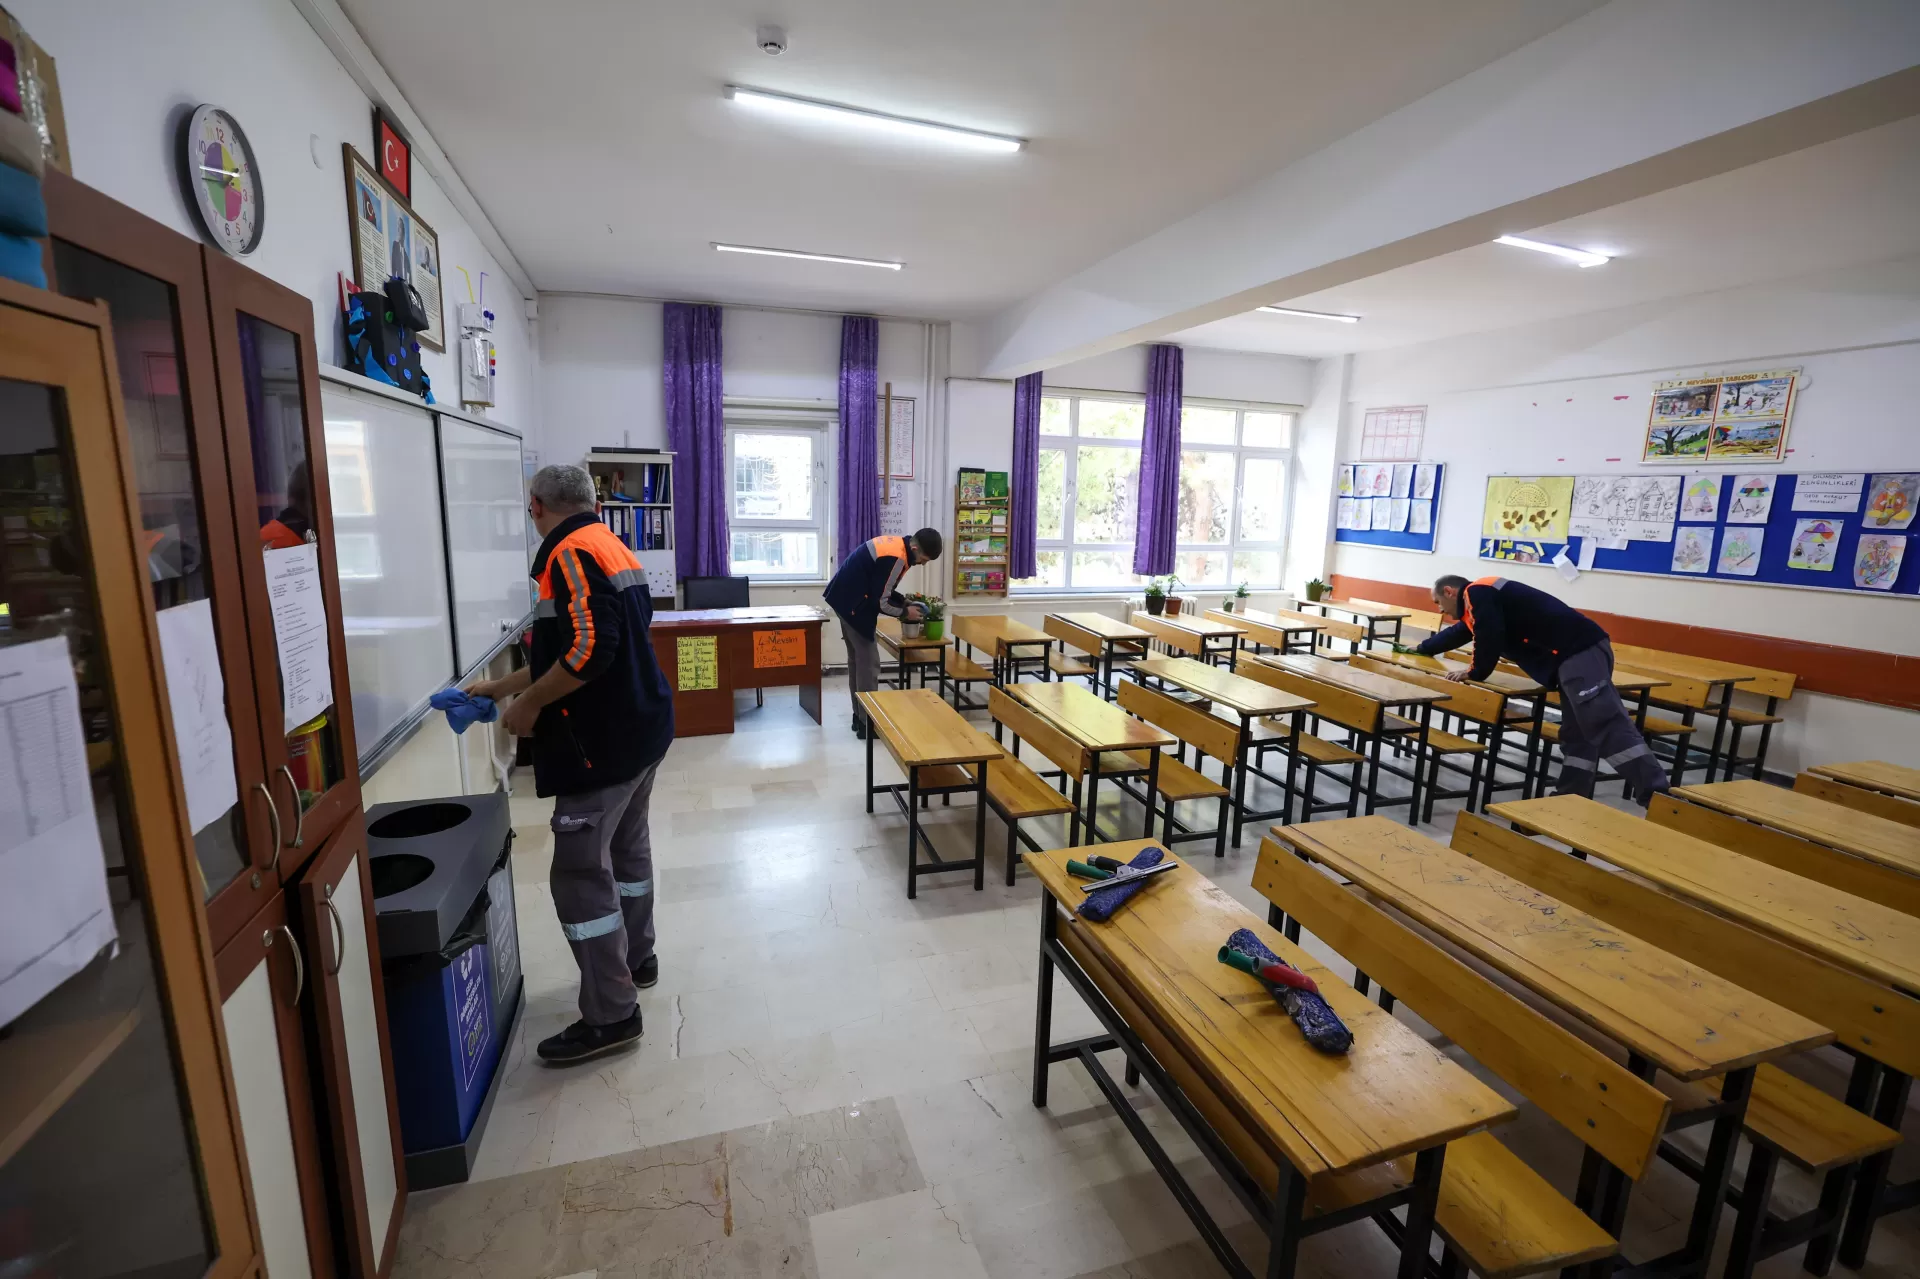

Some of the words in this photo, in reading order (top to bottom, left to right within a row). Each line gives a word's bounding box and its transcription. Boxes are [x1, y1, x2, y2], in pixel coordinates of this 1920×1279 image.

[215, 127, 225, 144] 12
[198, 140, 207, 155] 10
[242, 188, 249, 203] 3
[212, 211, 219, 222] 7
[242, 212, 248, 223] 4
[225, 221, 231, 237] 6
[235, 222, 241, 236] 5
[1725, 374, 1758, 382] TABLOSU
[768, 636, 798, 645] Mevsim
[771, 646, 783, 656] Ay
